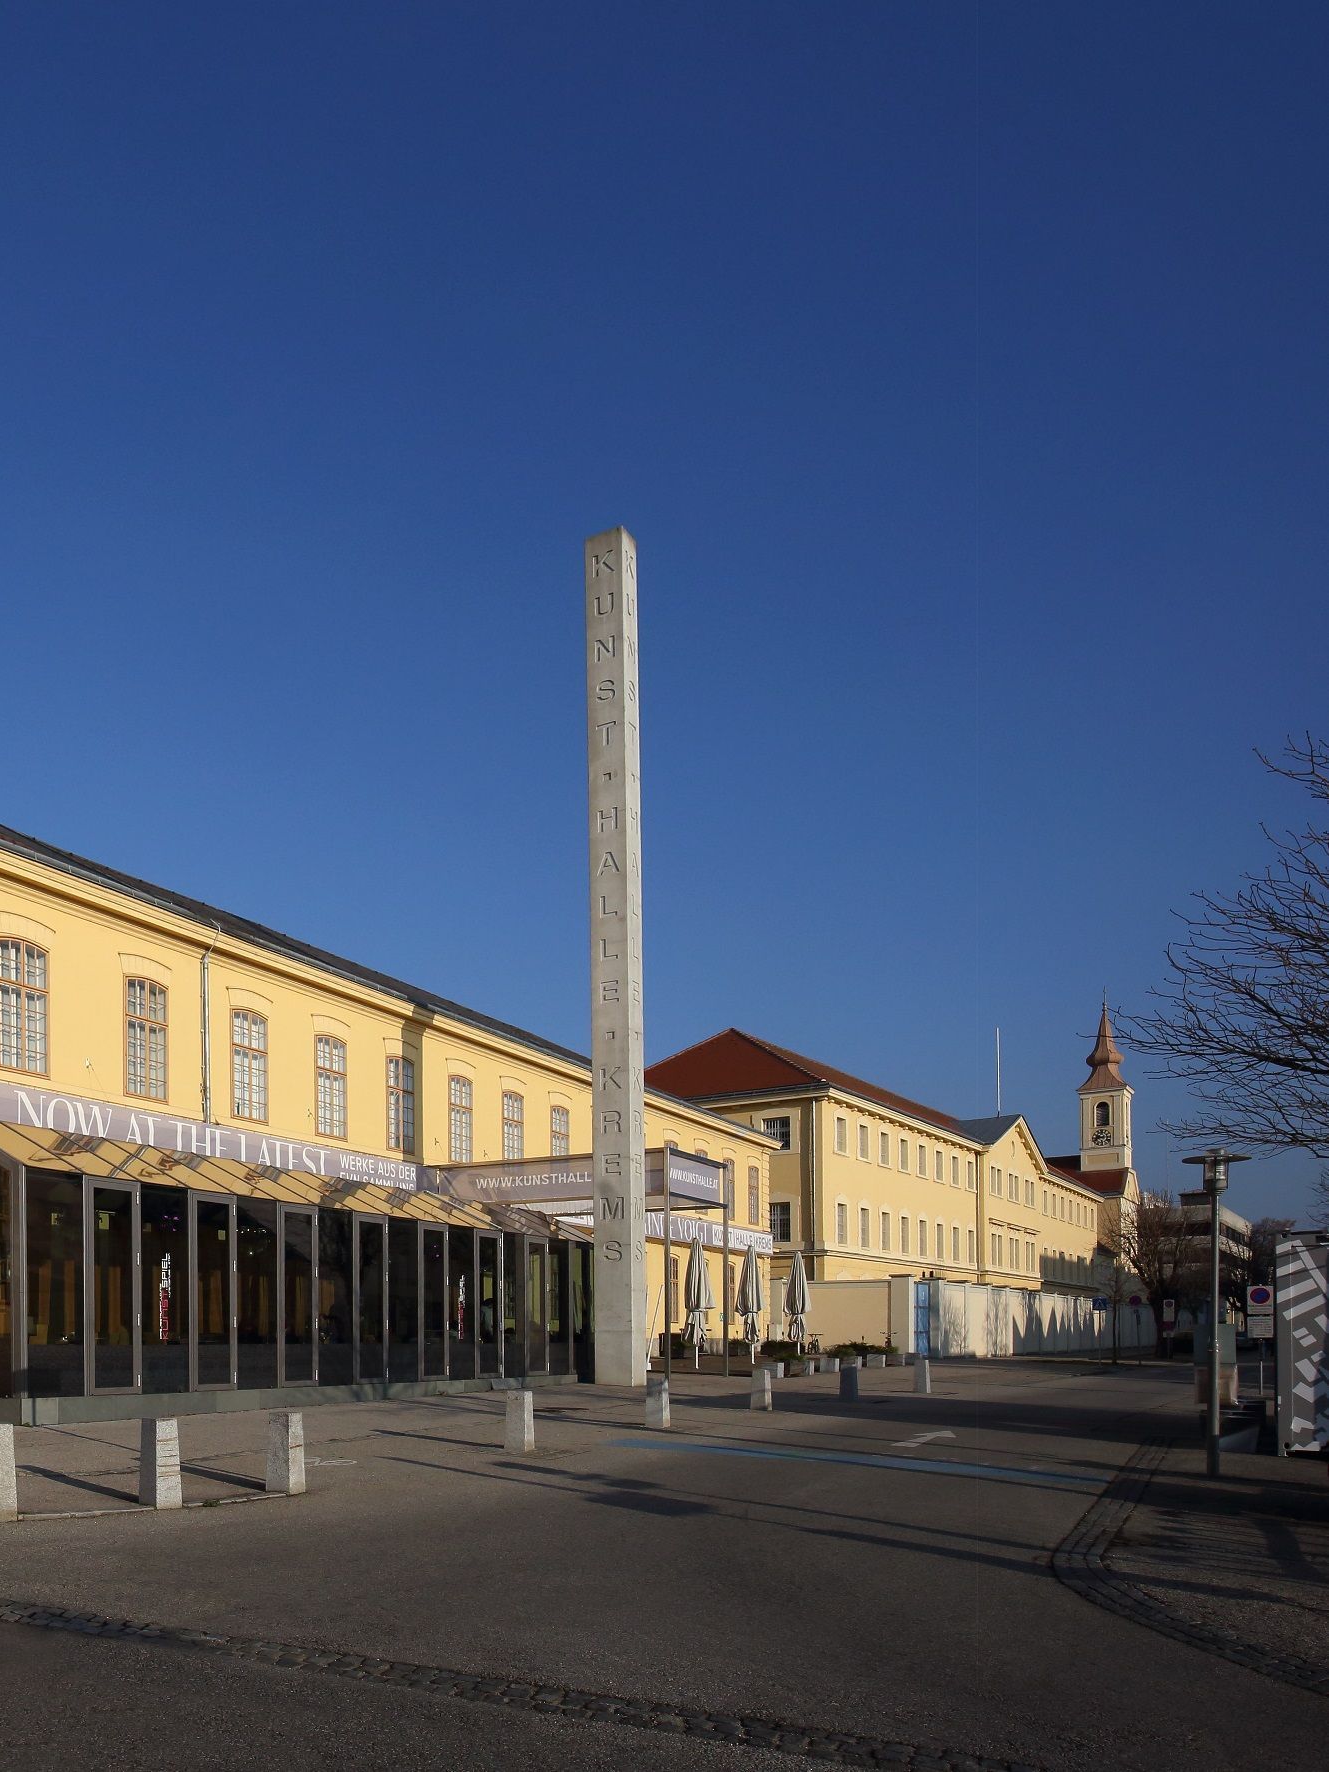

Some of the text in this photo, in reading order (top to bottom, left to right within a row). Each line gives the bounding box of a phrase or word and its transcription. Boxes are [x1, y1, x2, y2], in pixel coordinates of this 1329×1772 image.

[13, 1090, 113, 1138] NOW
[125, 1112, 162, 1146] AT
[167, 1120, 232, 1158] THE
[339, 1153, 417, 1182] WERKE AUS DER
[476, 1171, 592, 1189] WWW.KUNSTHALL
[678, 1217, 709, 1244] VOIGT
